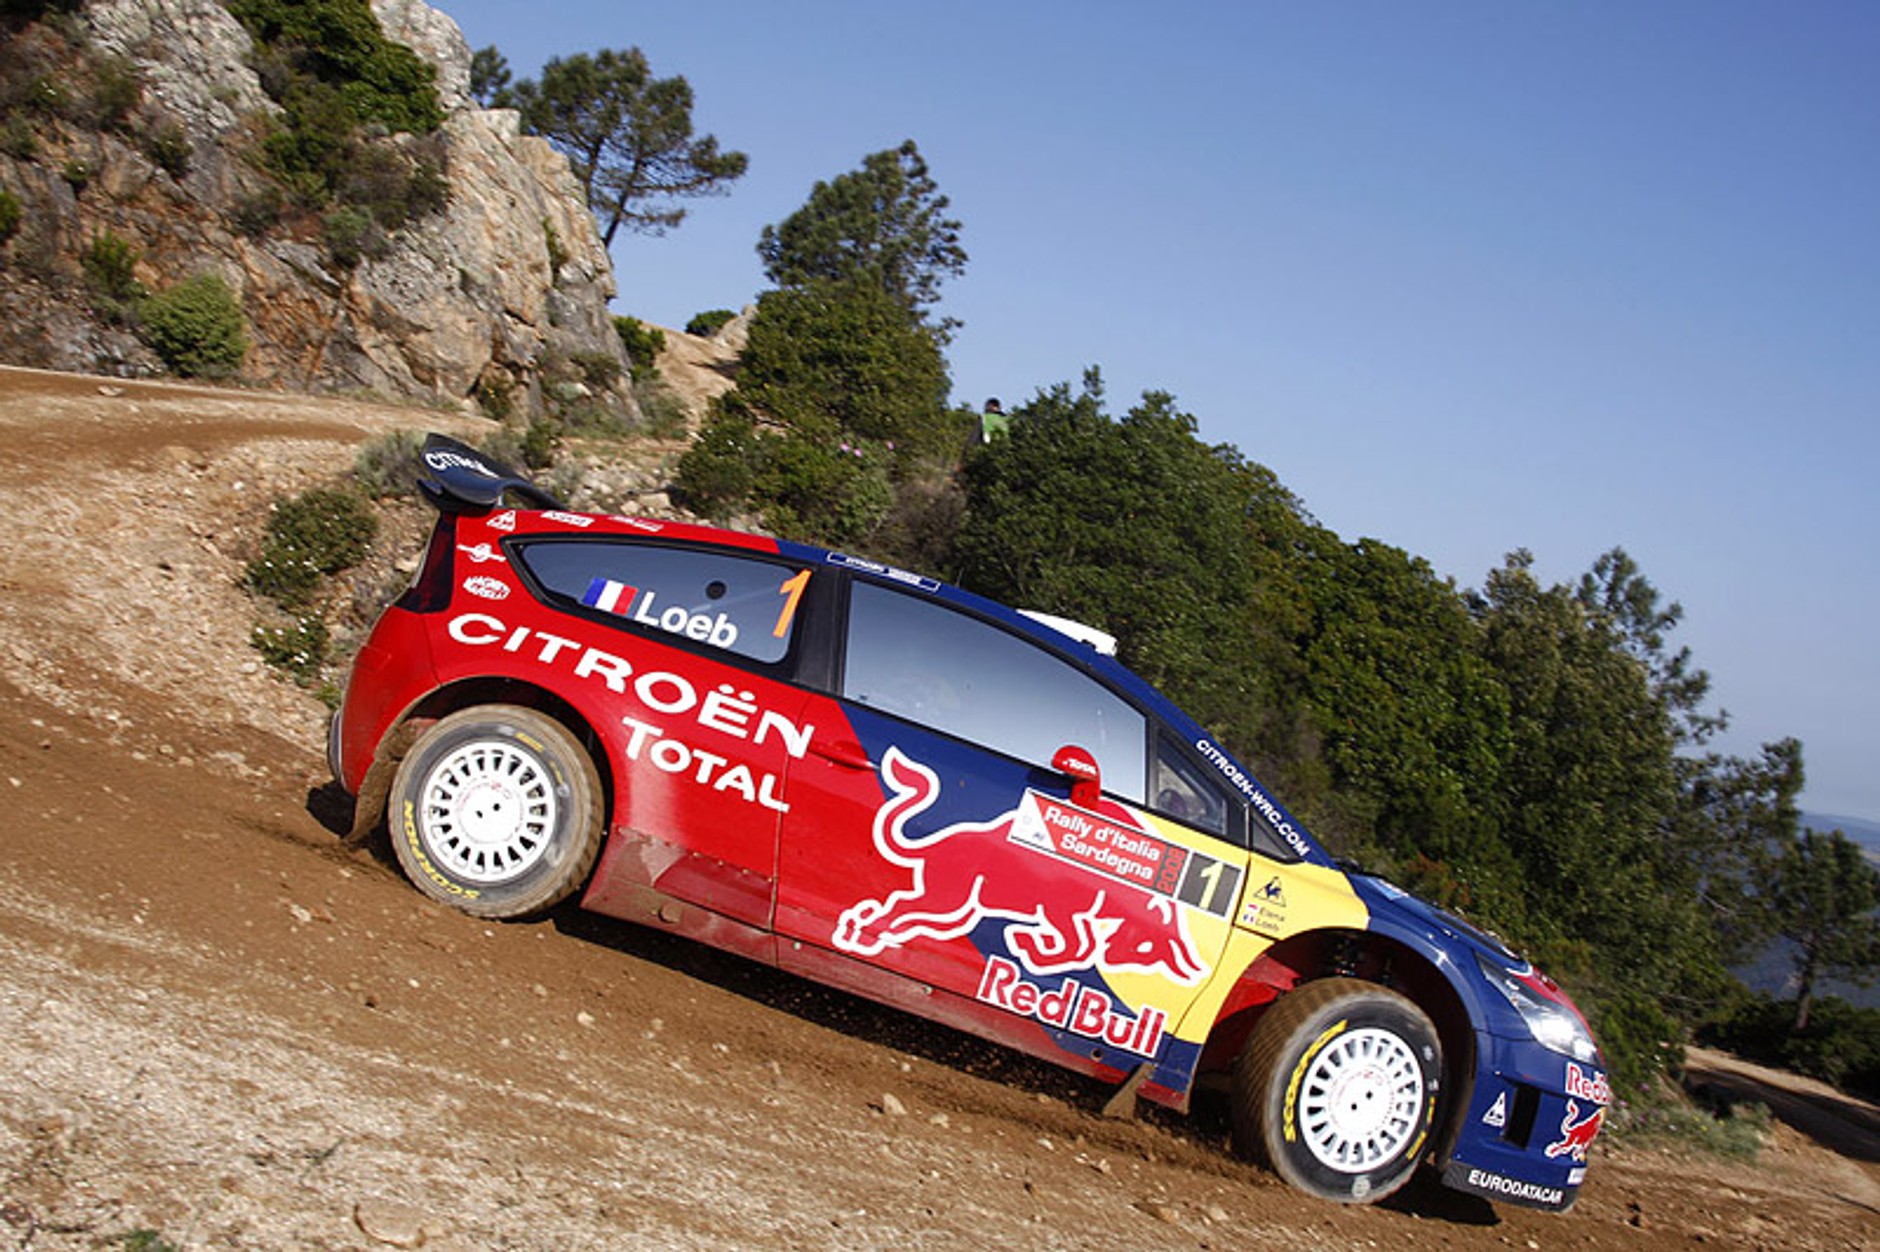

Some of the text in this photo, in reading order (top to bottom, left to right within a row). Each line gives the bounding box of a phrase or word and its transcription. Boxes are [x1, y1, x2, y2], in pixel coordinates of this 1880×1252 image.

[634, 592, 738, 650] Loeb
[773, 569, 812, 638] 1
[448, 613, 815, 759] CITROËN
[1044, 805, 1161, 861] Rally d'Italia
[1060, 832, 1154, 880] Sardegna
[1156, 847, 1187, 894] 2008
[1199, 860, 1225, 910] 1
[978, 955, 1166, 1057] Red Bull
